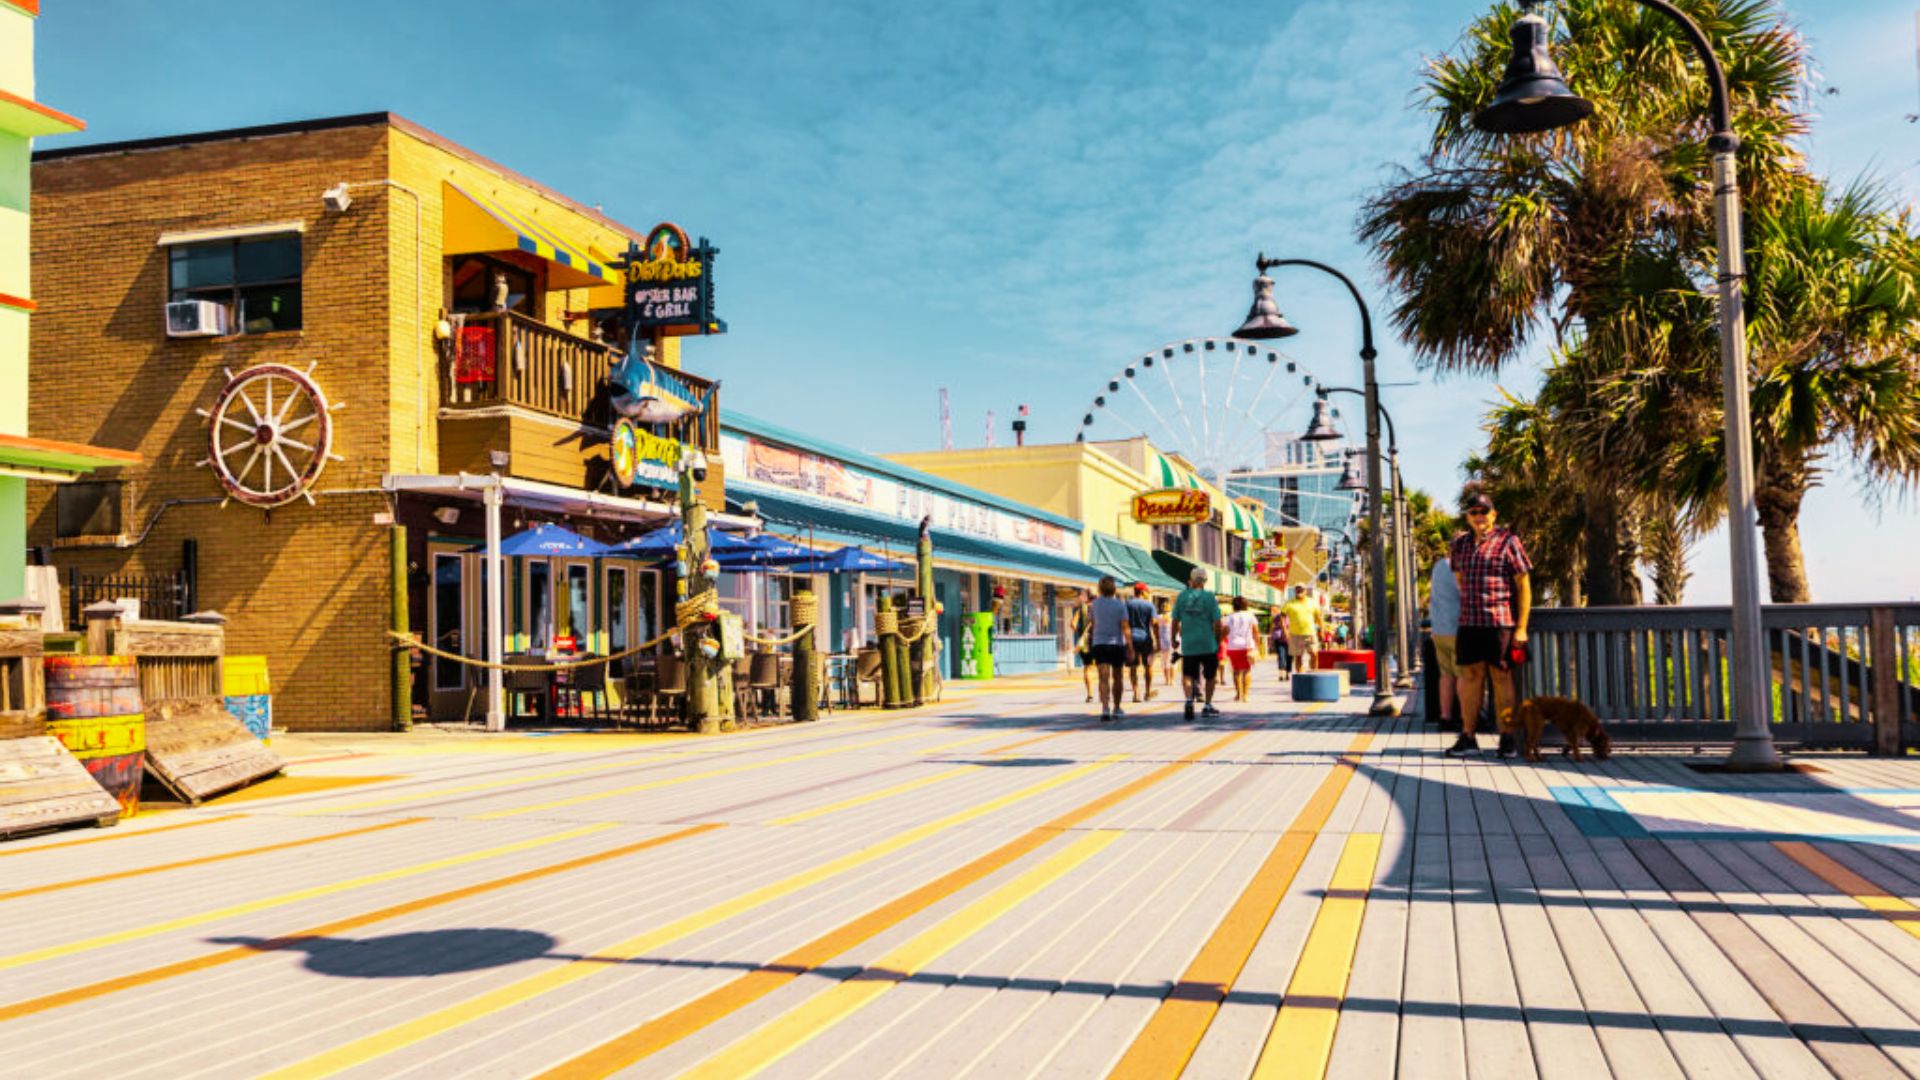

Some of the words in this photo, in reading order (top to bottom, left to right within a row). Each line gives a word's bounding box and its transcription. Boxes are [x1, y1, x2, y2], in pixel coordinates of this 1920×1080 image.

[635, 288, 670, 304] OYSTER
[673, 287, 697, 302] BAR
[655, 302, 690, 319] GRILL
[961, 625, 977, 676] ATM
